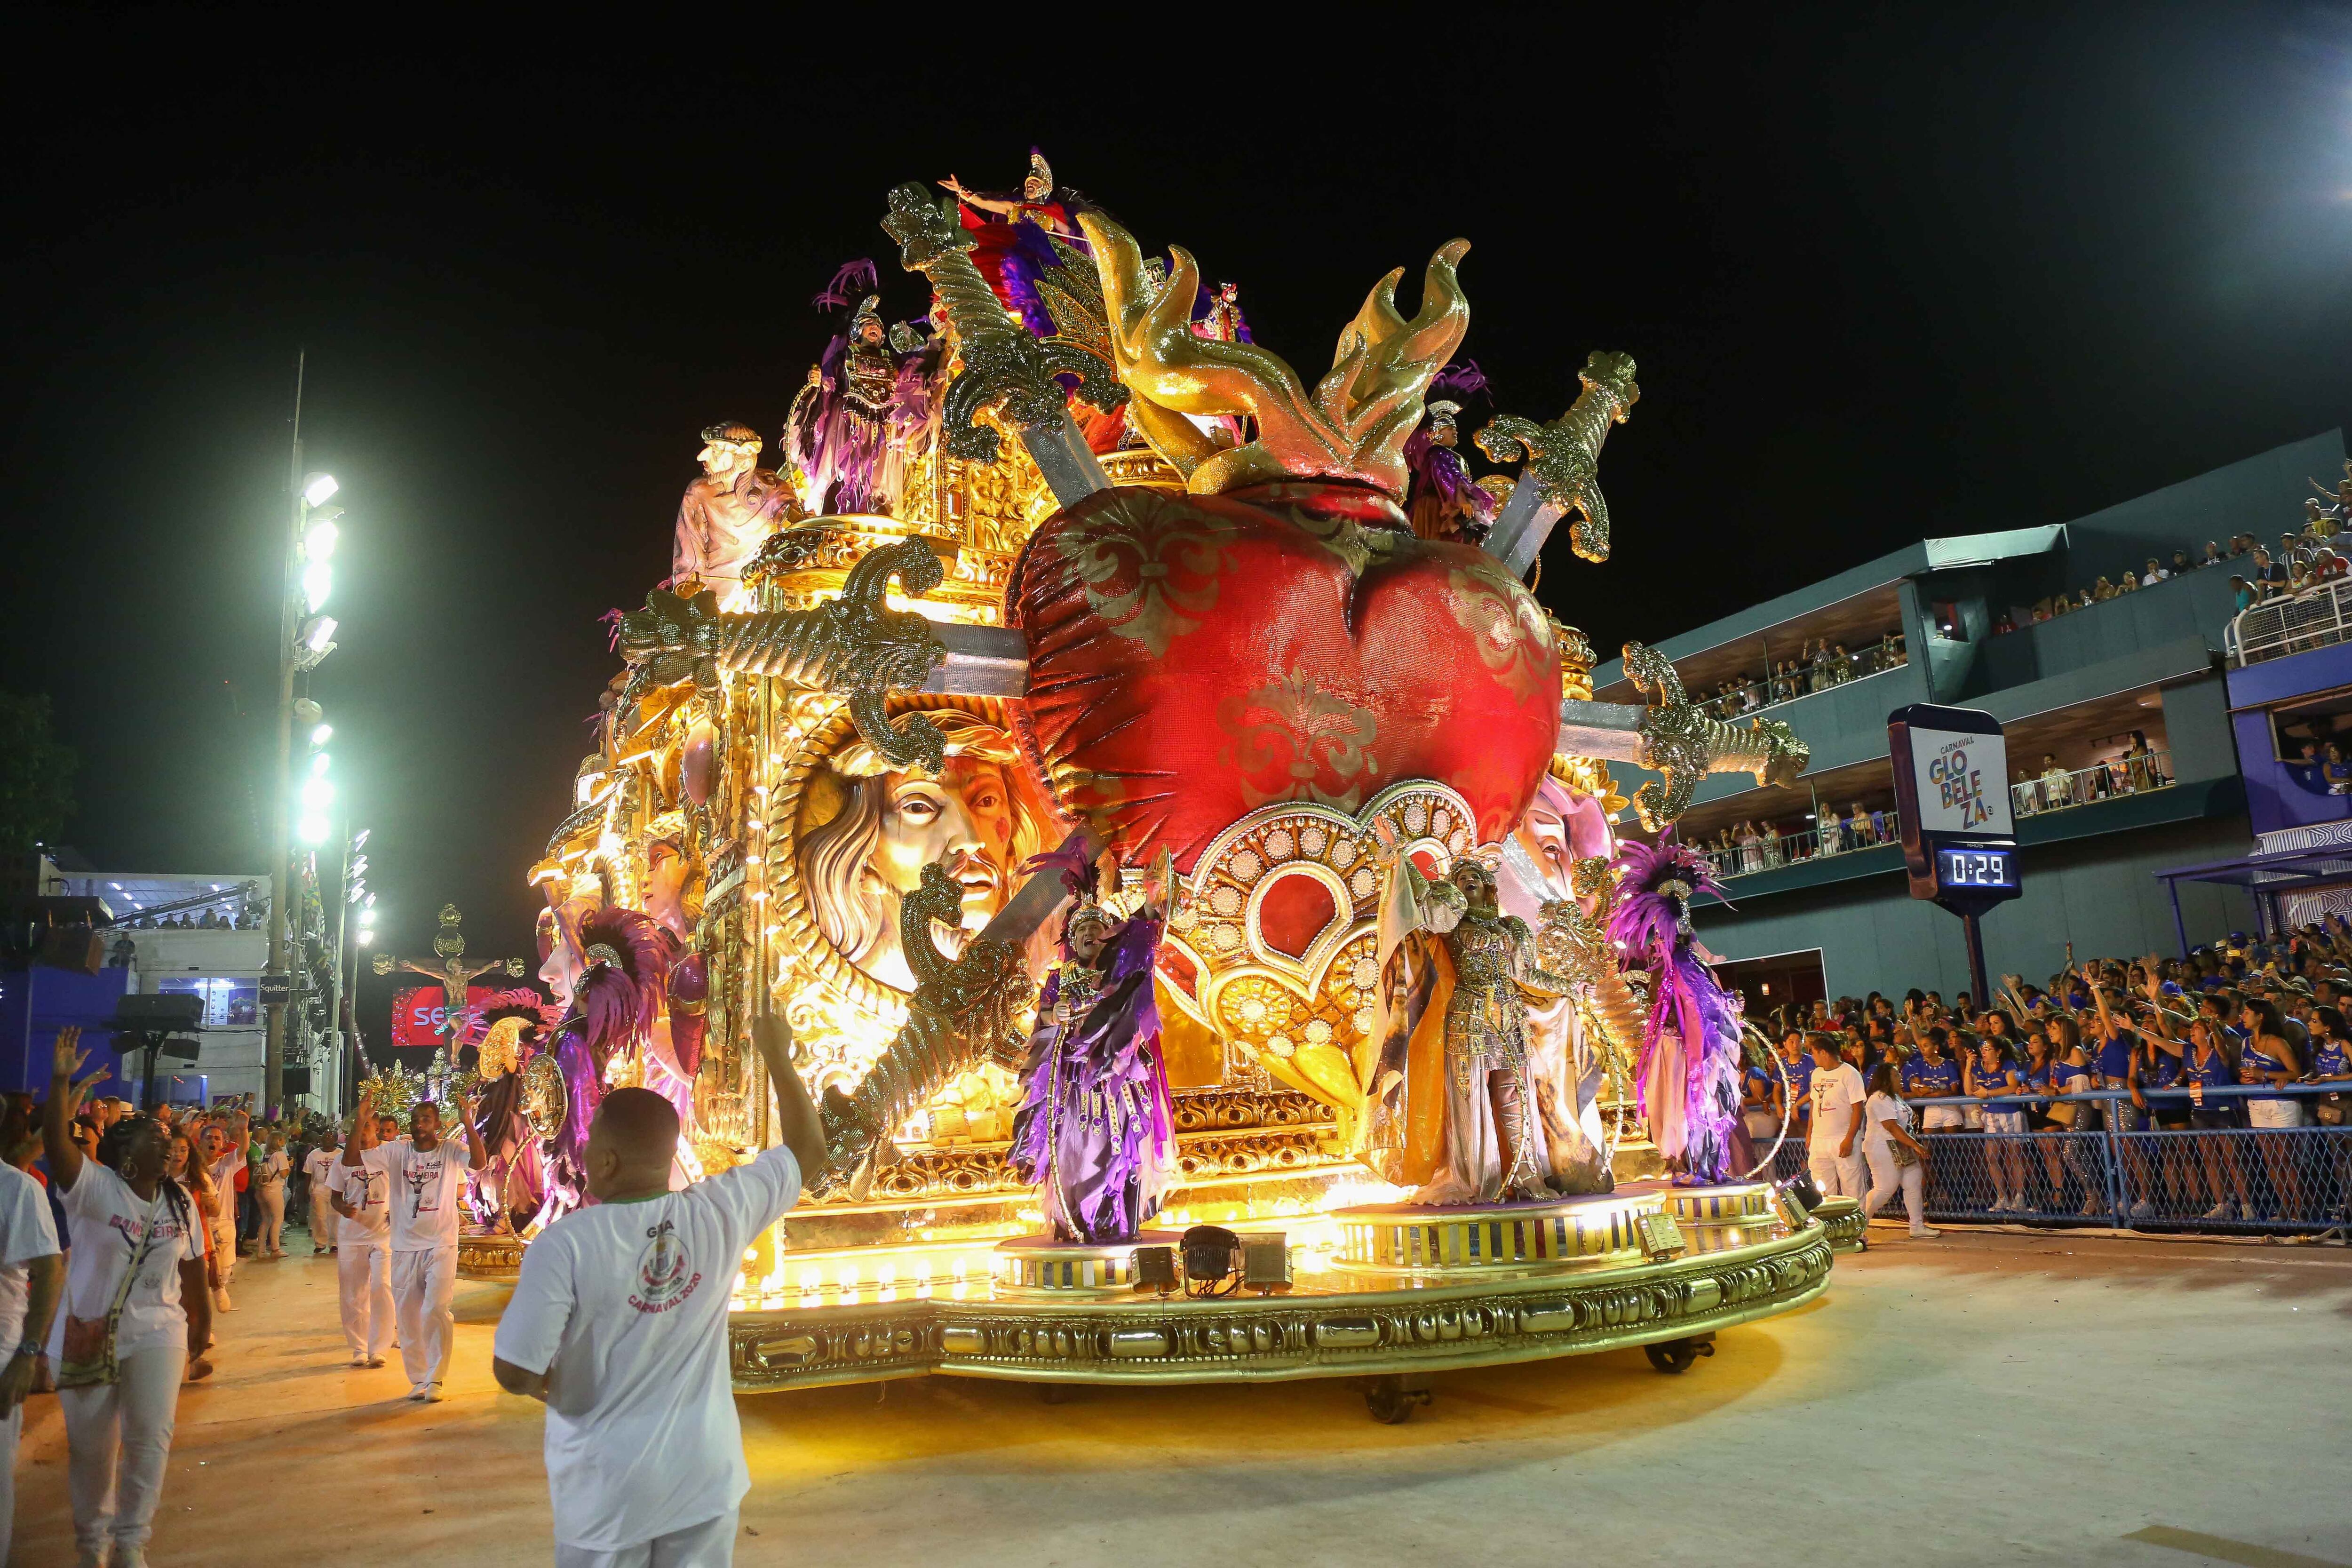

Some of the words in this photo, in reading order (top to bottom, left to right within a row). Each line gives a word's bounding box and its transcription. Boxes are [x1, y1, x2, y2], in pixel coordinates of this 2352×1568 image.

[1940, 736, 1974, 754] CARNAVAL
[1930, 750, 1967, 785] GLO
[1941, 770, 1982, 810] BELE
[1960, 797, 1988, 830] ZA
[1952, 854, 2004, 884] 0:29
[261, 984, 289, 993] Squitter
[628, 1294, 682, 1313] CARNAVAL
